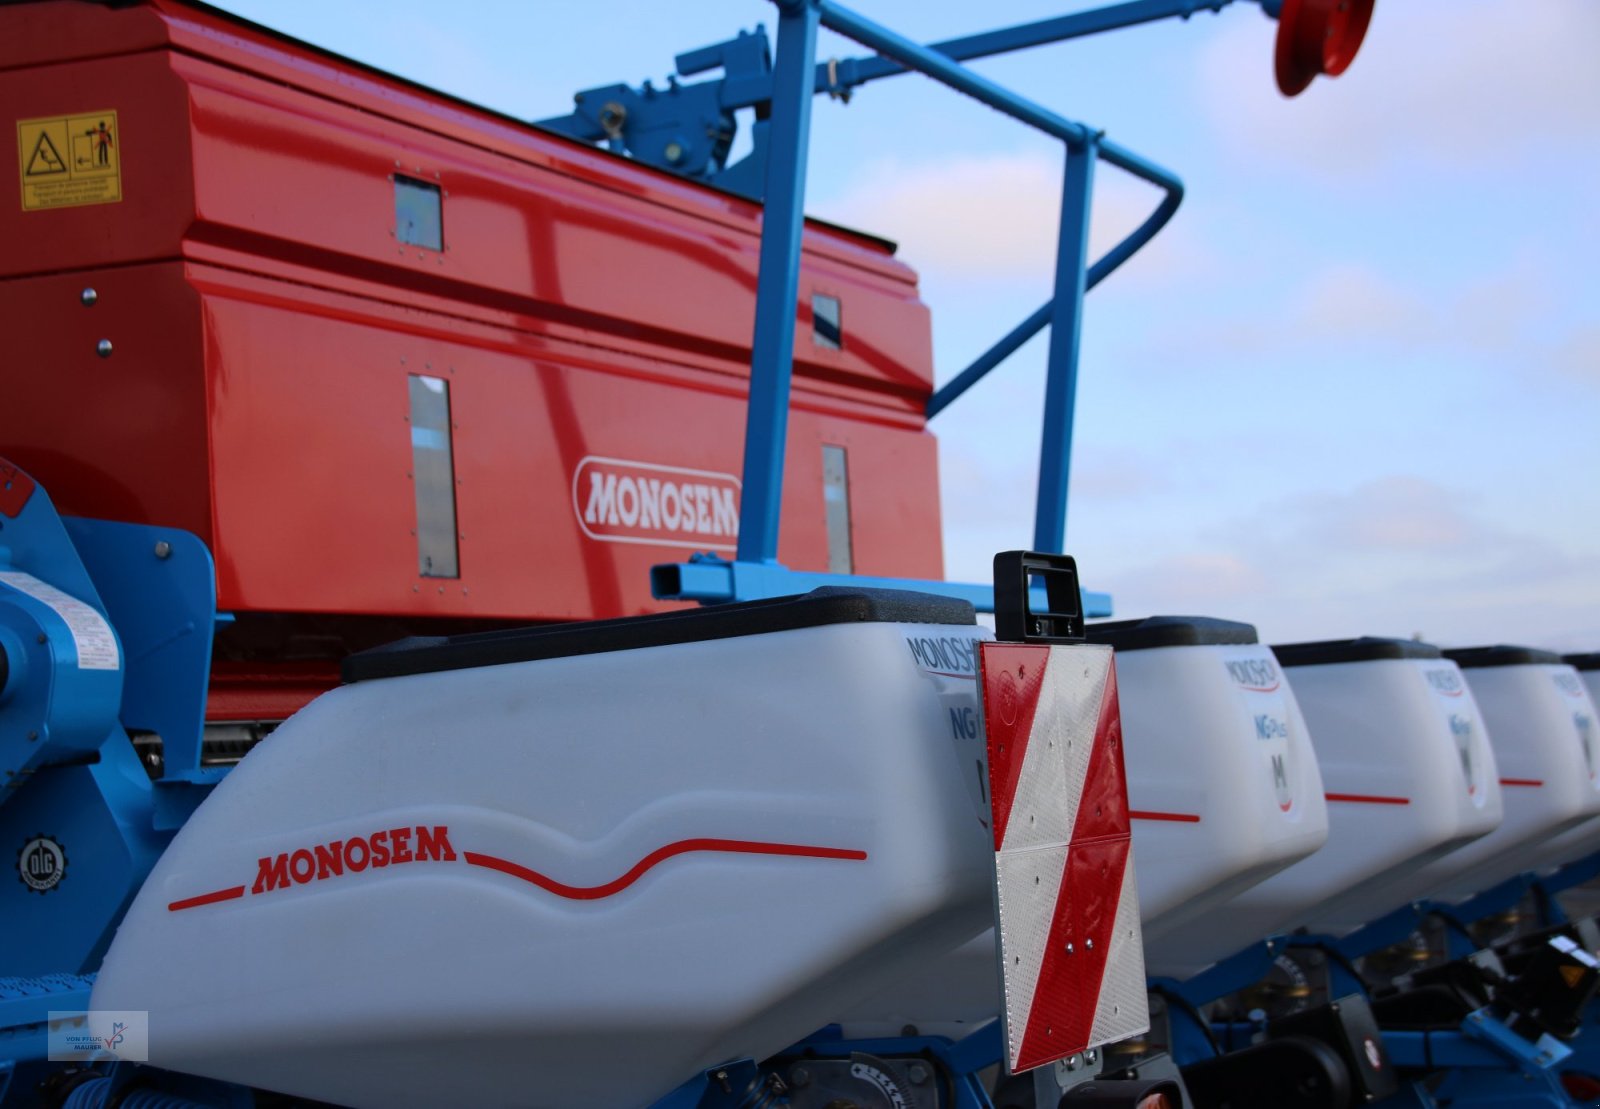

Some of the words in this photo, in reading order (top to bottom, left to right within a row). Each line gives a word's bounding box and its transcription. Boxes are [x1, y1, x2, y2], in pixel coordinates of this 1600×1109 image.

[585, 471, 740, 537] MONOSEM
[906, 636, 976, 672] MONOSH
[251, 826, 457, 894] MONOSEM
